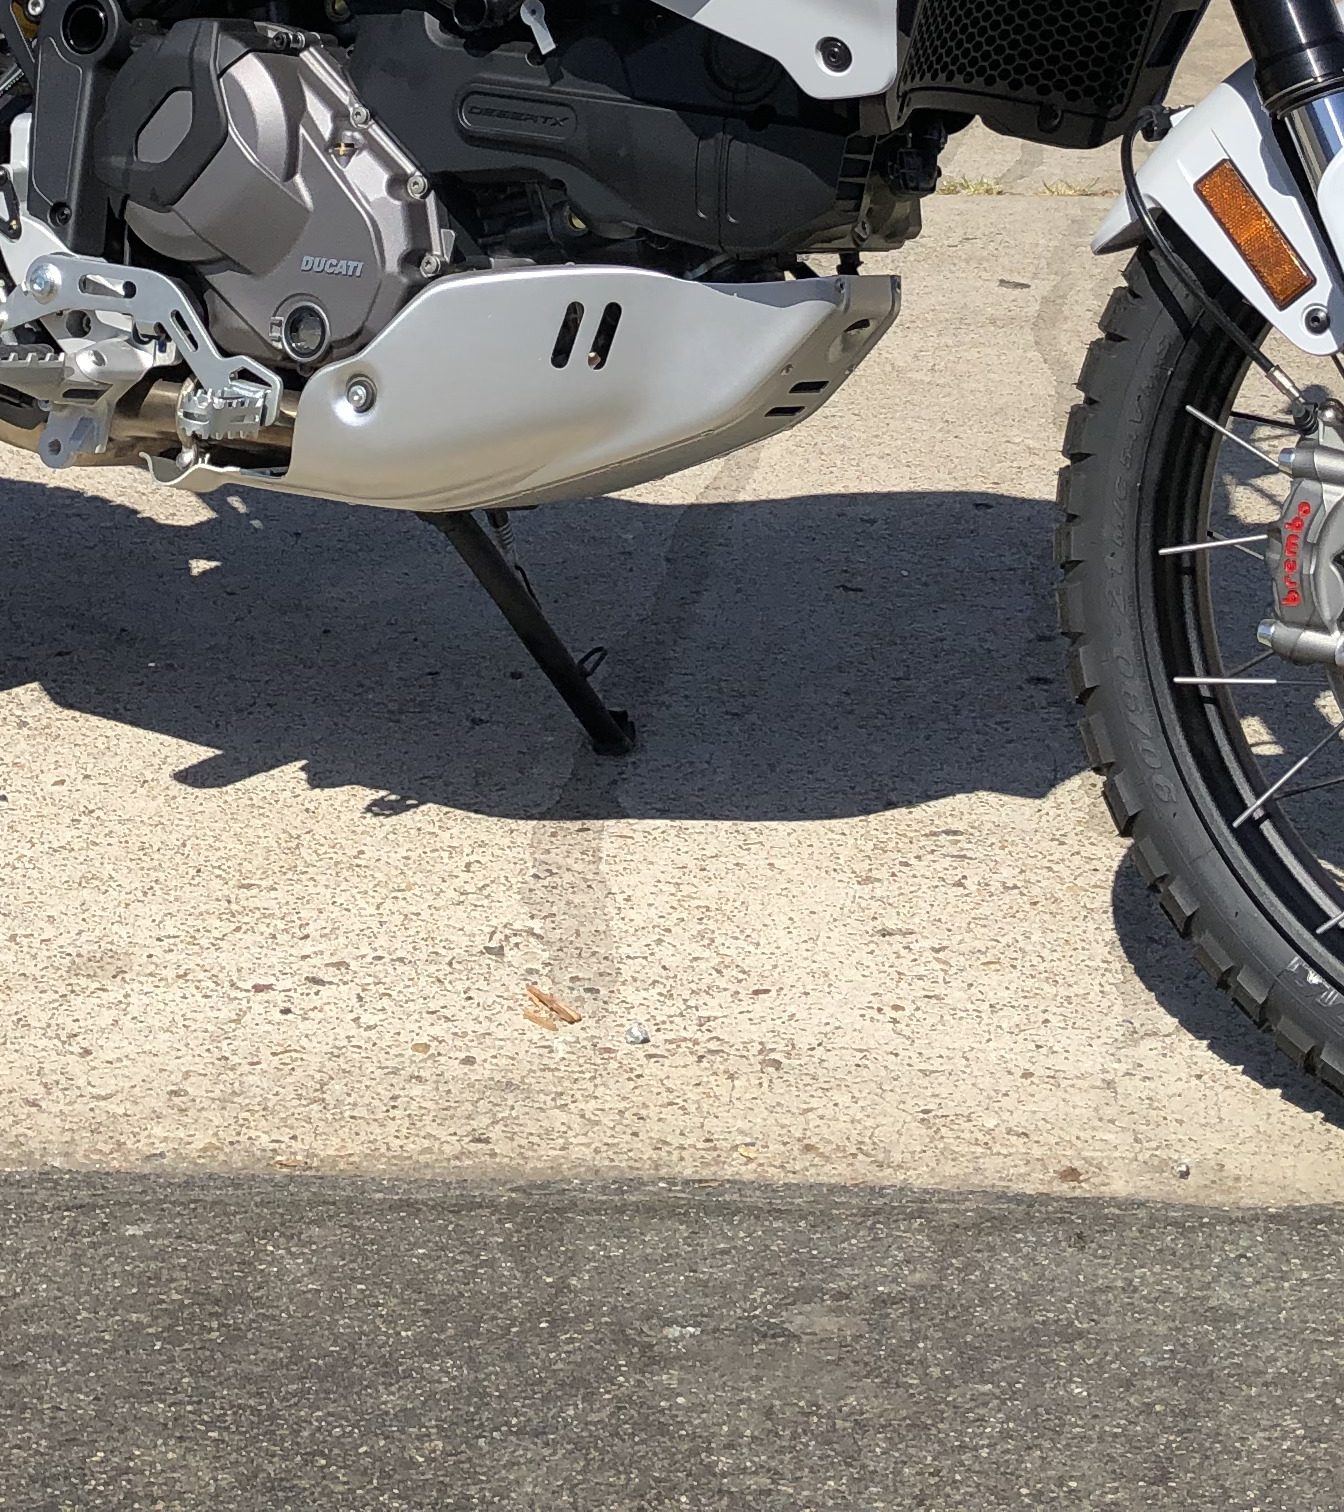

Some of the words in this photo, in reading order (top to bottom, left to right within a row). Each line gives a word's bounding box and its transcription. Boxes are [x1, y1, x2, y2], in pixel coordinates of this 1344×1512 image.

[467, 105, 570, 128] DESERTX
[300, 255, 365, 278] DUCATI
[1280, 500, 1312, 607] brembo
